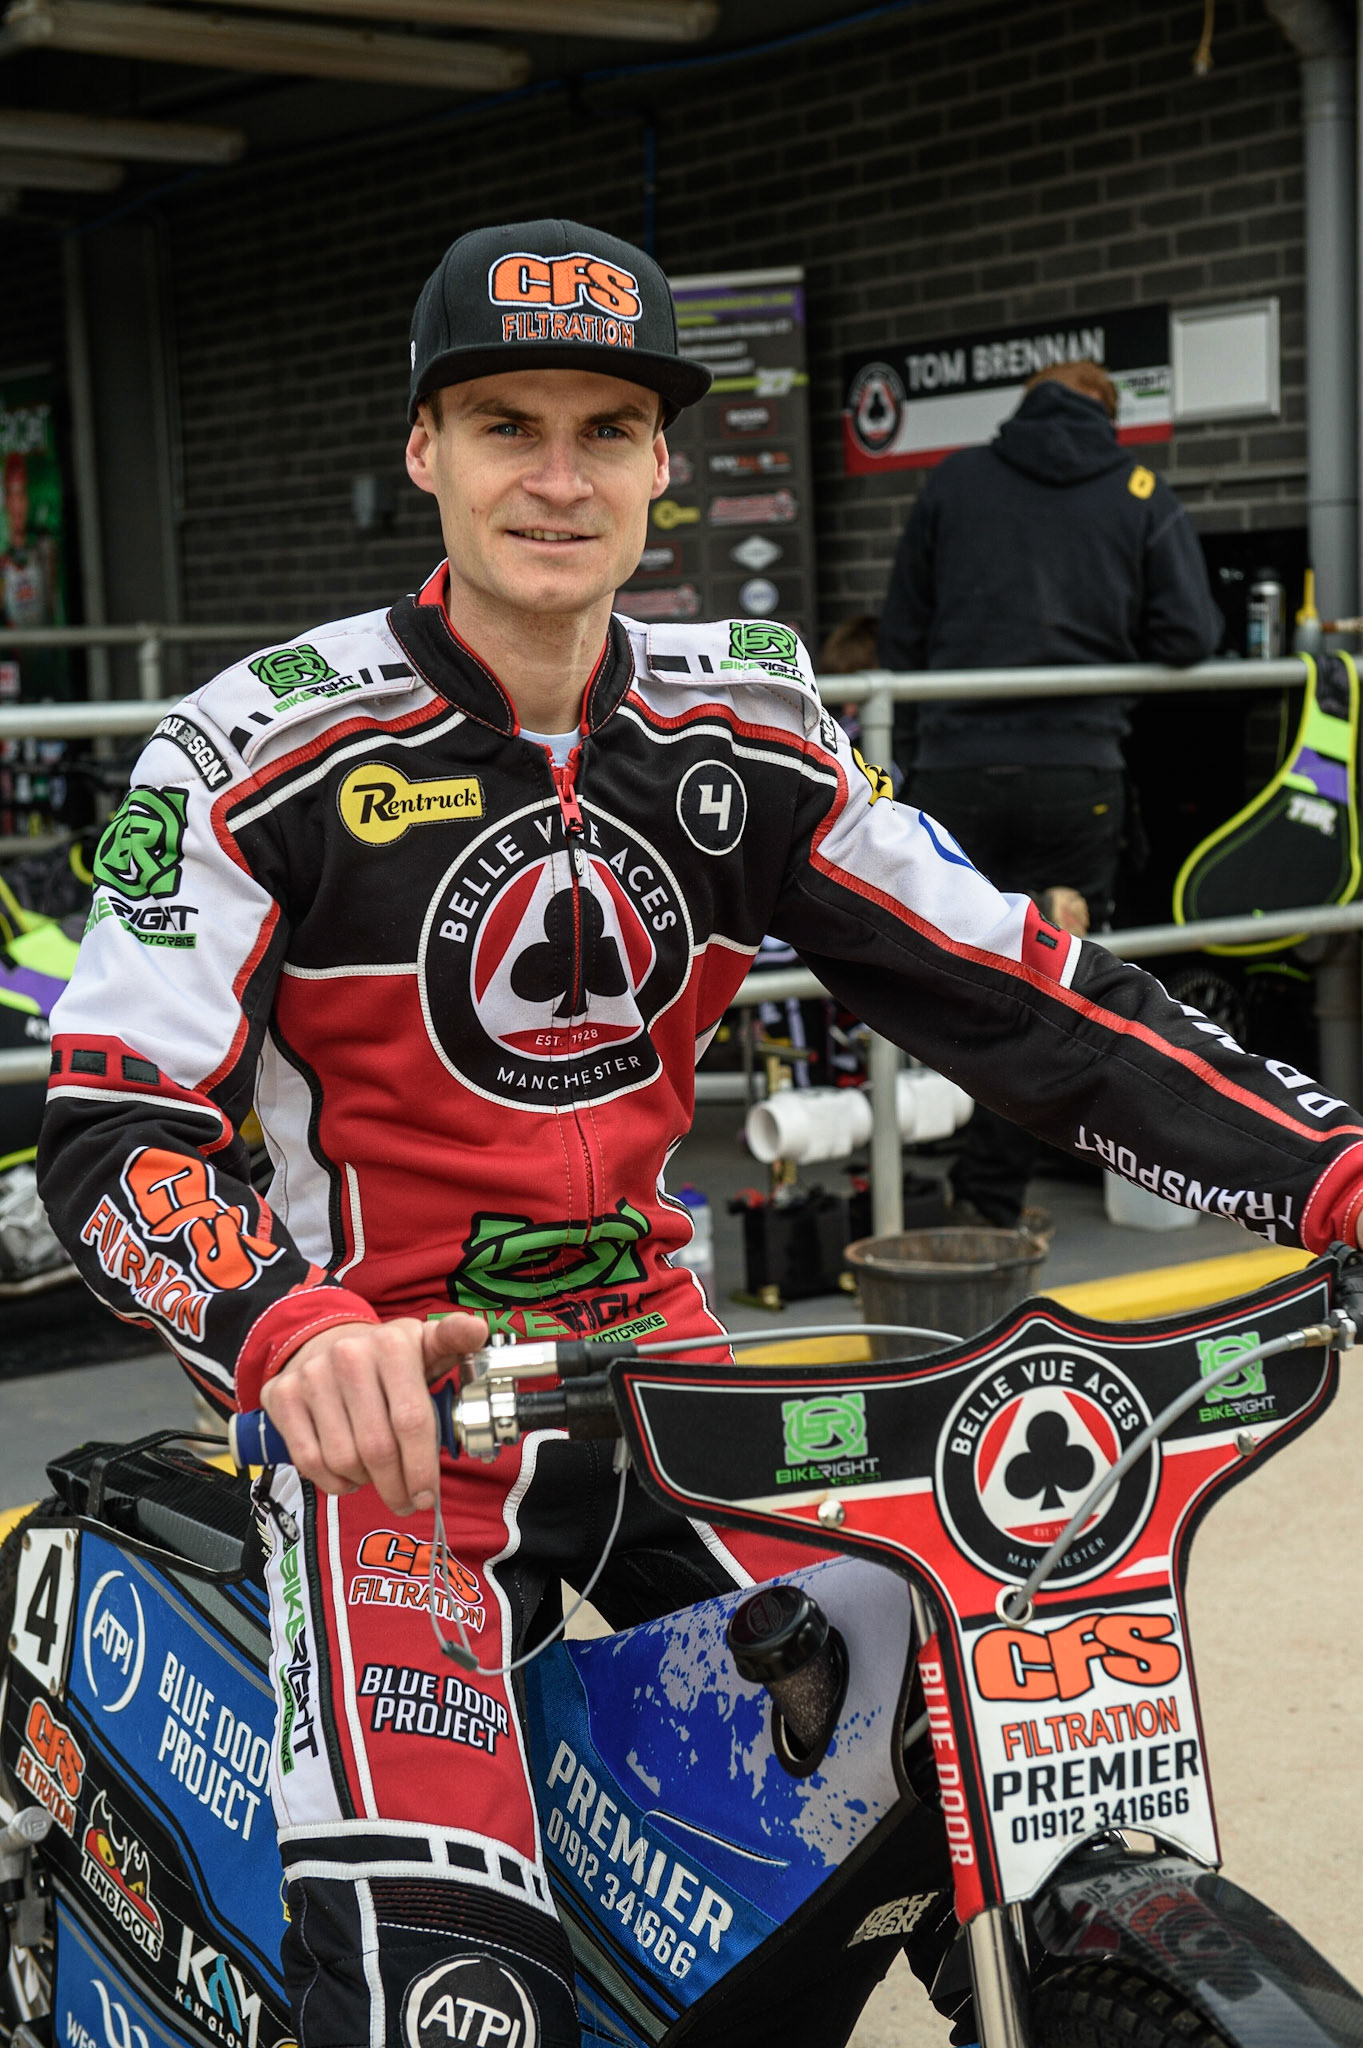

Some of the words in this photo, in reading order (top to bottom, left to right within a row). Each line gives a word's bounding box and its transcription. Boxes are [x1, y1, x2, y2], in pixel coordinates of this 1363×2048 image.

[488, 252, 643, 321] CFS
[502, 311, 635, 350] FILTRATION
[906, 349, 967, 391] TOM
[273, 674, 354, 713] BIKERIGHT
[720, 660, 805, 679] BIKERIGHT
[352, 781, 478, 825] Rentruck
[698, 783, 733, 831] 4
[439, 834, 525, 943] BELLE
[609, 847, 677, 932] ACES
[571, 1028, 599, 1044] 1928
[497, 1055, 642, 1091] MANCHESTER
[1074, 1124, 1295, 1231] TRANSPORT
[951, 1376, 1014, 1457] BELLE
[1020, 1359, 1076, 1384] VUE
[1083, 1371, 1140, 1431] ACES
[1198, 1394, 1276, 1423] BIKERIGHT
[775, 1456, 880, 1485] BIKERIGHT
[356, 1528, 483, 1605] CFS
[24, 1543, 63, 1666] 4
[348, 1576, 487, 1634] FILTRATION
[93, 1608, 135, 1676] ATPI
[972, 1611, 1182, 1702] CFS
[158, 1651, 215, 1741] BLUE
[213, 1705, 272, 1797] DOO
[361, 1665, 437, 1700] BLUE
[445, 1677, 509, 1736] DOOR
[374, 1696, 498, 1754] PROJECT
[1000, 1695, 1182, 1762] FILTRATION
[25, 1697, 86, 1801] CFS
[157, 1714, 261, 1842] PROJECT
[992, 1738, 1200, 1813] PREMIER
[546, 1739, 734, 1954] PREMIER
[936, 1762, 975, 1867] DOOR
[1011, 1805, 1086, 1845] 01912
[1095, 1786, 1190, 1828] 341666
[547, 1807, 600, 1893] 01912
[600, 1871, 697, 1980] 341666
[420, 1994, 521, 2048] ATPI
